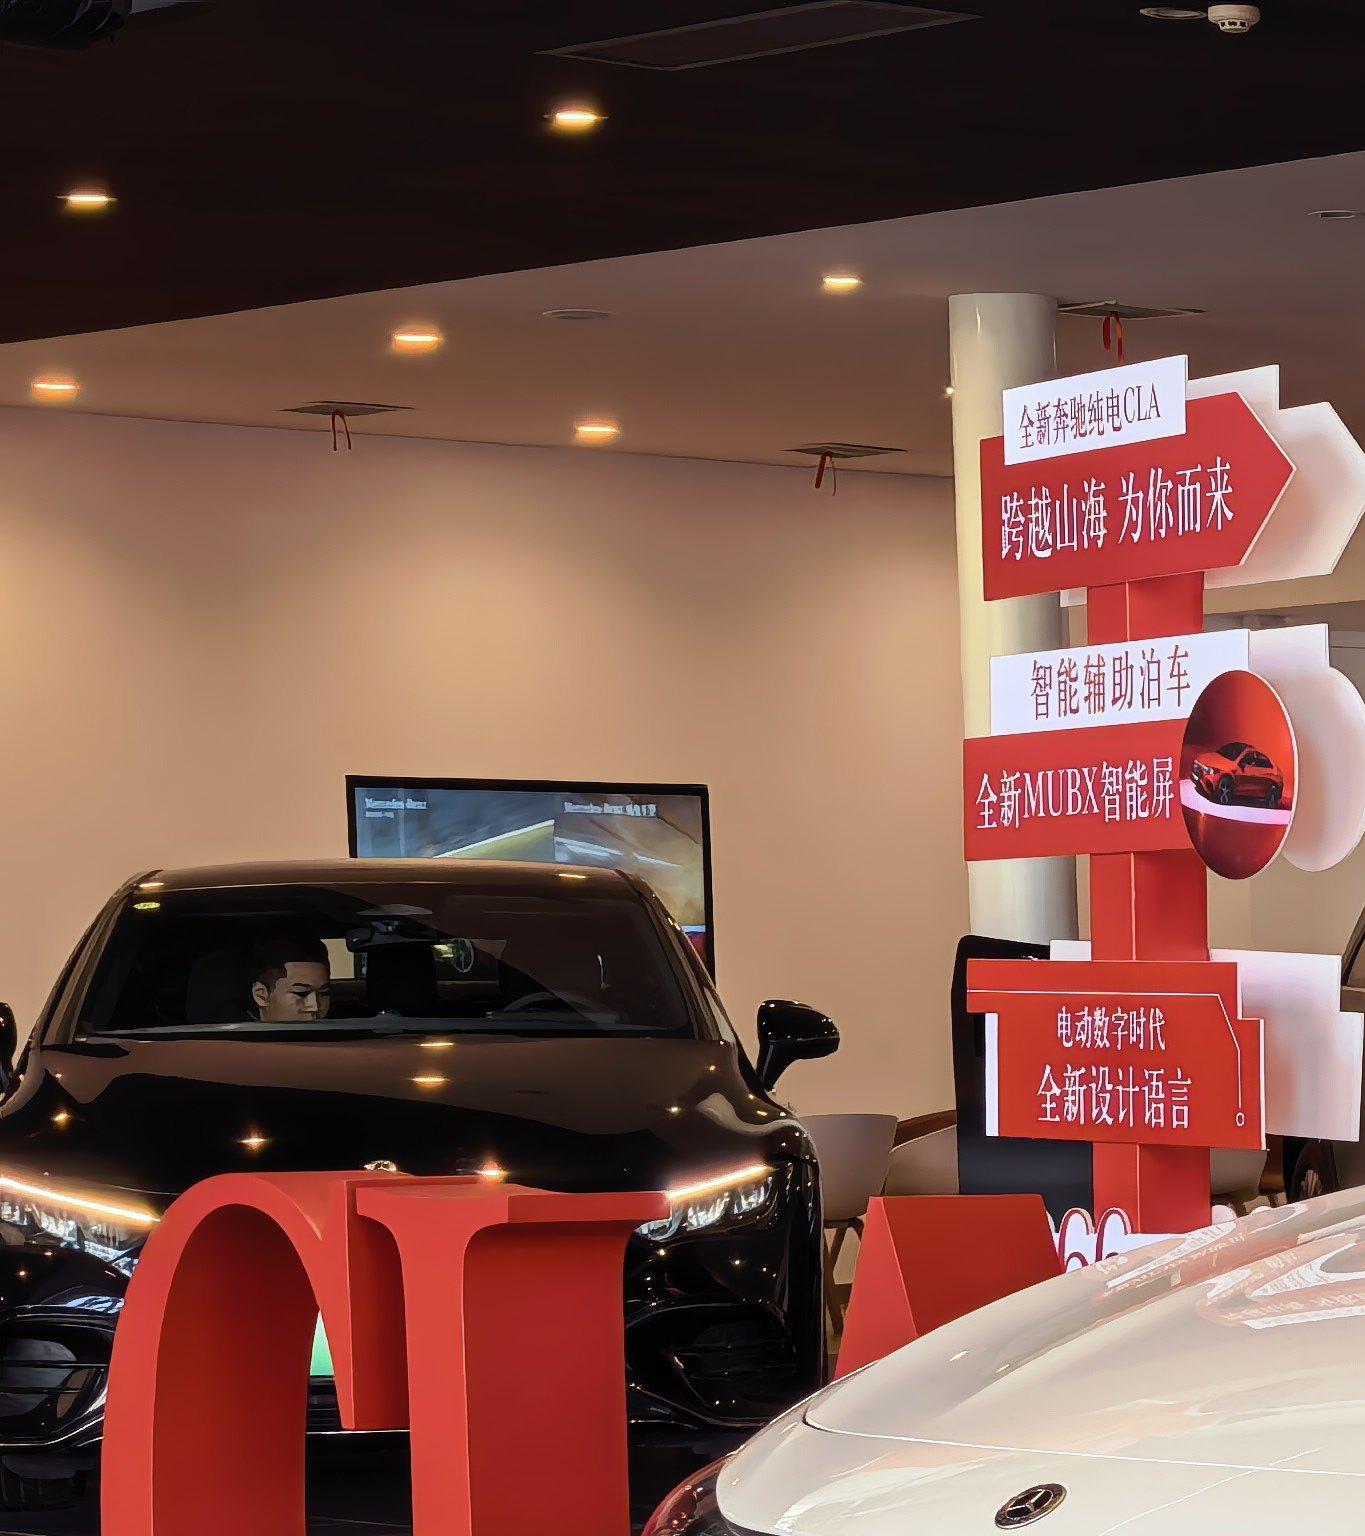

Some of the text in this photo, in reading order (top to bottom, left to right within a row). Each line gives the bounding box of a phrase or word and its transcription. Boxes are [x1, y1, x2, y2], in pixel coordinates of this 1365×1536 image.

[1018, 383, 1162, 450] 全新奔驰纯电CLA
[1000, 455, 1234, 562] 跨越山海 为你而来
[1030, 644, 1192, 721] 智能辅助泊车
[1056, 1006, 1166, 1052] 电动数字时代
[1037, 1064, 1192, 1130] 全新设计语言
